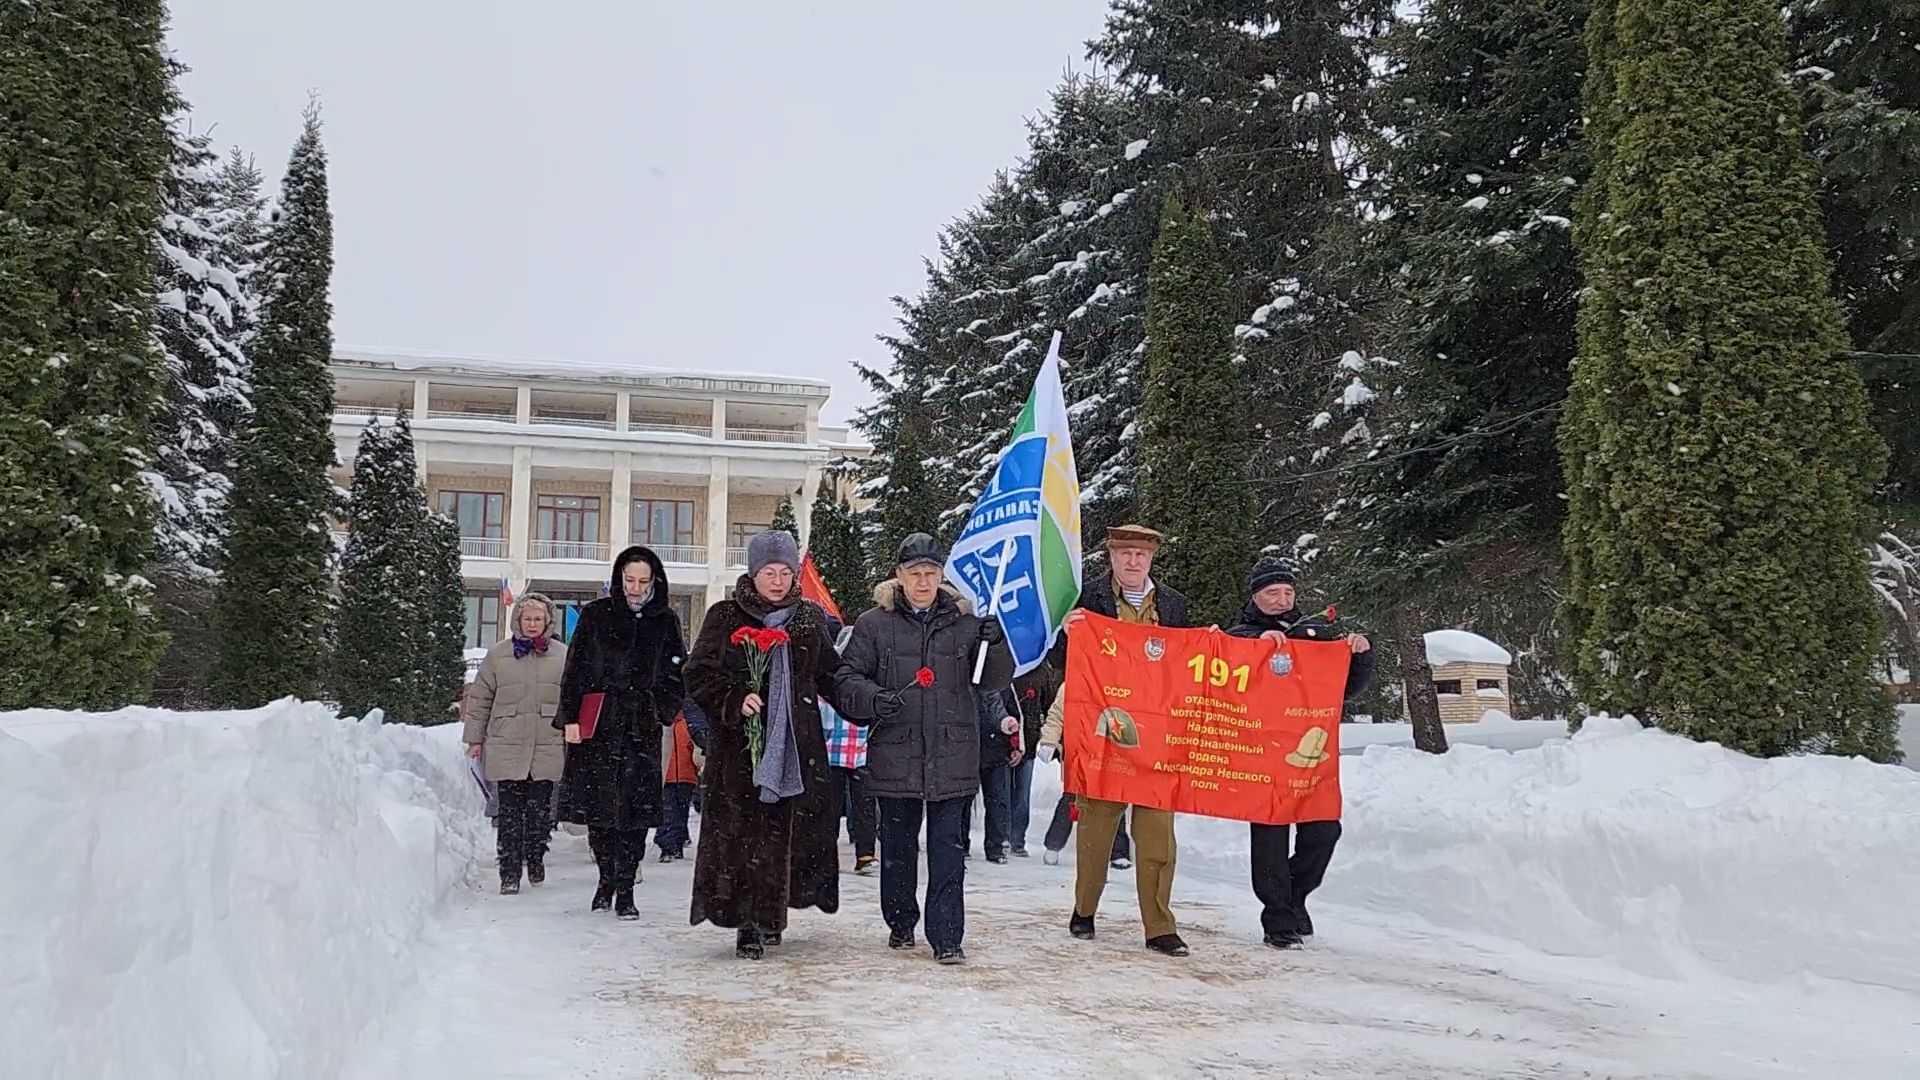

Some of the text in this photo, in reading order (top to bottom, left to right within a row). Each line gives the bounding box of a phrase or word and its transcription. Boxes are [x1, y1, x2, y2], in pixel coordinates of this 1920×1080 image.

[1188, 654, 1250, 693] 191
[1103, 685, 1132, 698] СССР
[1184, 695, 1248, 714] отдельный
[1188, 751, 1230, 765] ордена
[1217, 767, 1271, 784] Невского
[1190, 779, 1219, 792] полк
